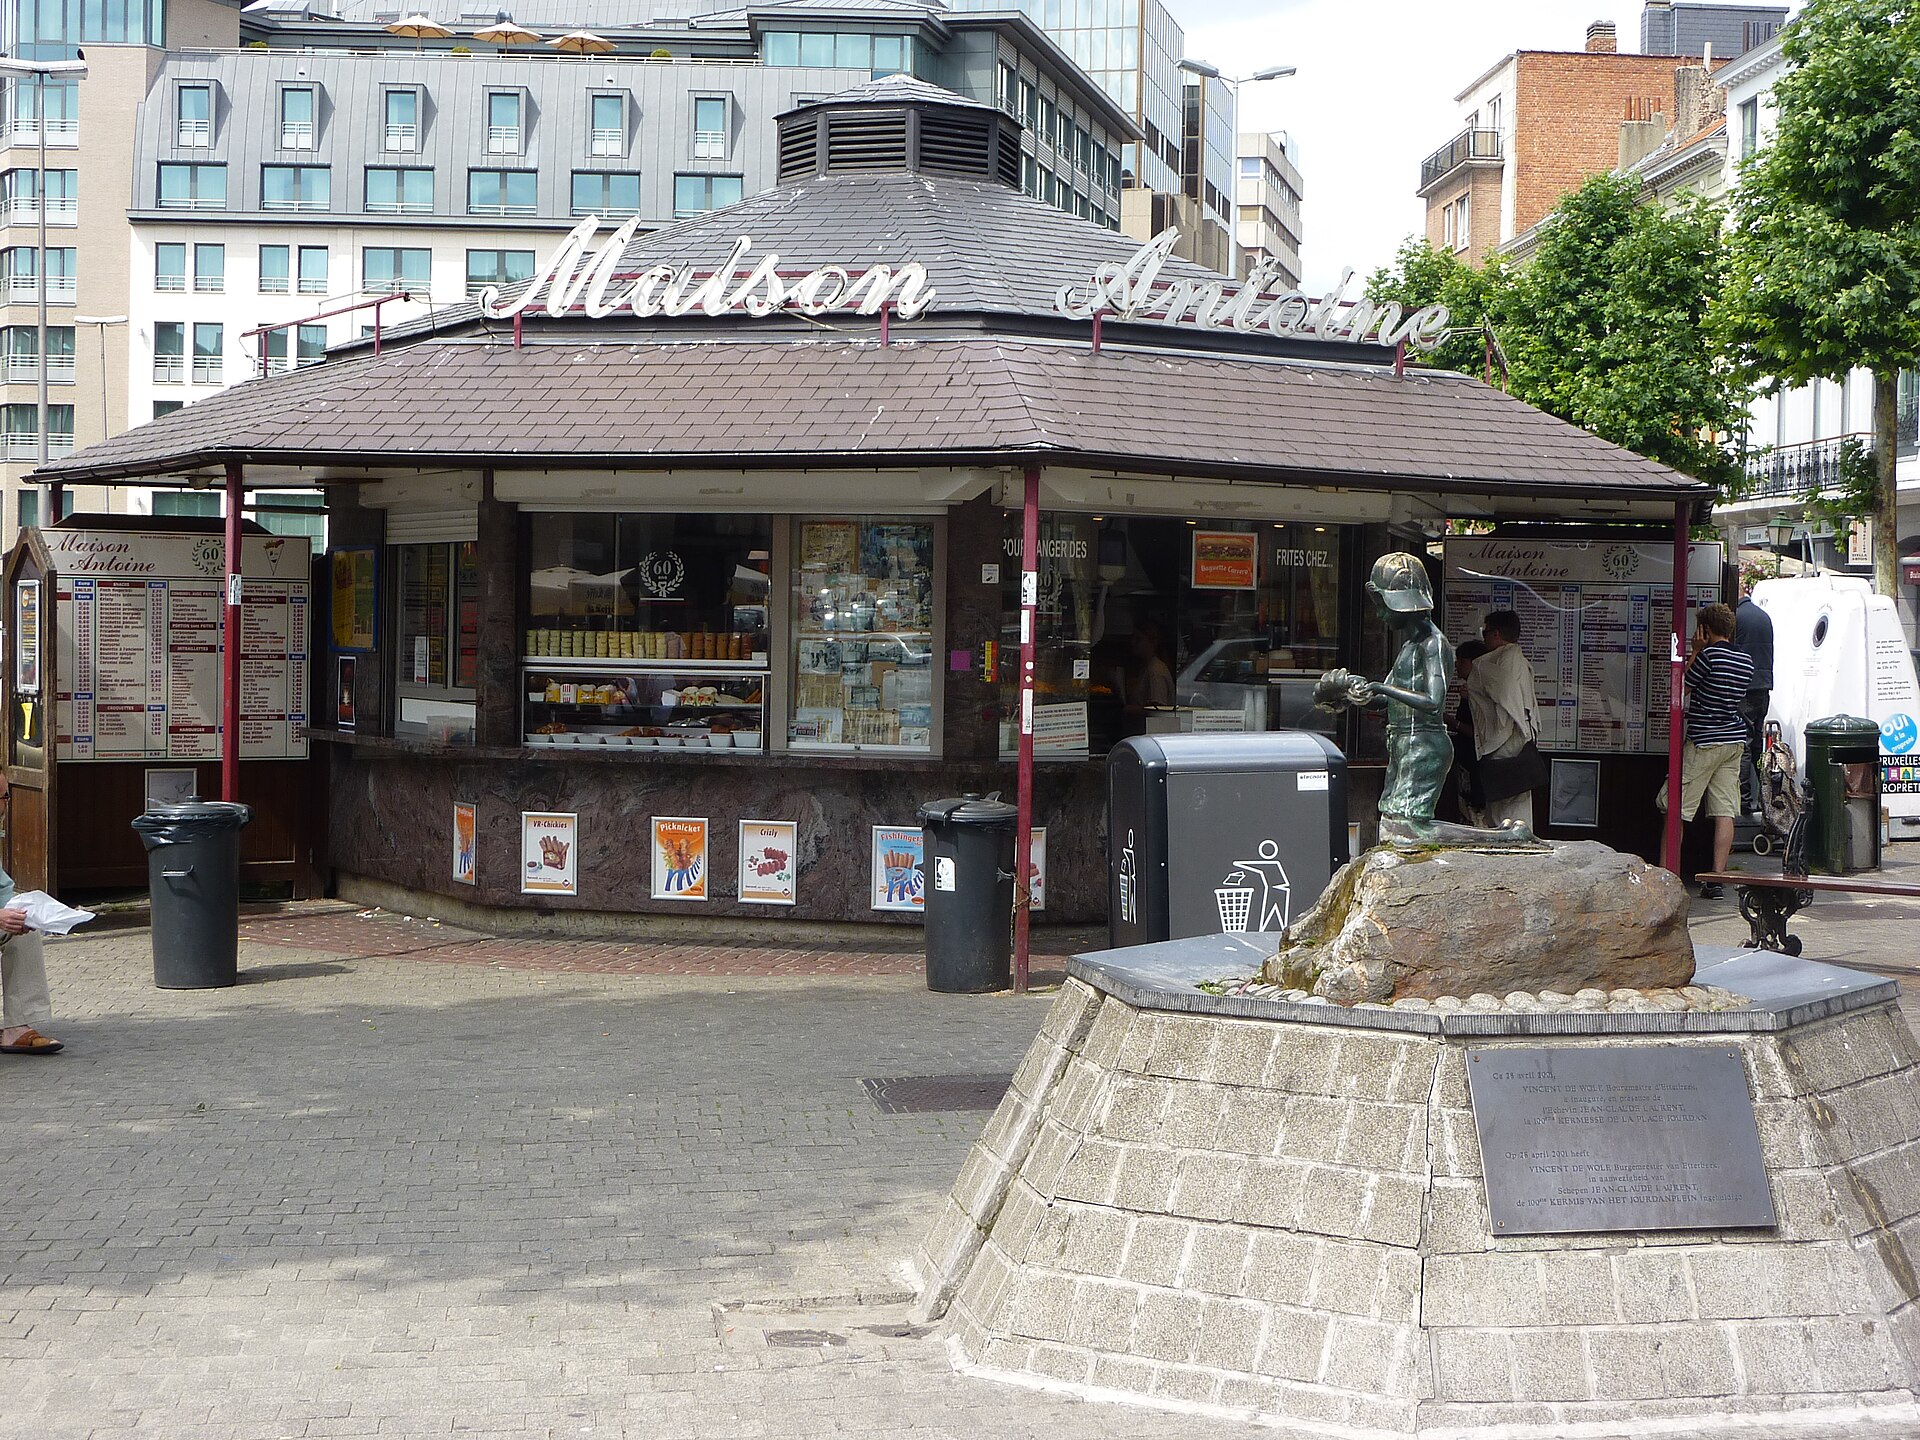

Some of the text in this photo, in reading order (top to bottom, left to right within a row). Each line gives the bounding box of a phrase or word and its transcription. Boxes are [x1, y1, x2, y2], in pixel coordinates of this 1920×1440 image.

[479, 214, 1452, 352] Maison Antoine
[48, 533, 130, 553] Maison
[1070, 540, 1087, 558] DES
[202, 548, 219, 561] 60
[1276, 548, 1304, 567] FRITES
[1469, 542, 1546, 560] Maison
[70, 552, 156, 573] Antoine
[653, 560, 672, 575] 60
[1612, 555, 1629, 567] 60
[1489, 560, 1569, 578] Antoine
[1882, 714, 1910, 736] OUI
[660, 822, 701, 832] Picknicker
[1522, 1085, 1561, 1093] VINCENT
[1558, 1116, 1604, 1124] KERMESSE
[1636, 1115, 1664, 1123] PLACE
[1666, 1114, 1708, 1122] JOURDAN
[1505, 1152, 1517, 1160] Op
[1531, 1150, 1549, 1159] april
[1552, 1150, 1568, 1158] 2001
[1570, 1150, 1590, 1158] heeft
[1529, 1165, 1569, 1173] VINCENT
[1614, 1163, 1664, 1172] Burgemeester
[1558, 1183, 1699, 1195] Schepen JEAN-CLAUDE LAURENT,
[1516, 1199, 1525, 1207] de
[1550, 1198, 1584, 1206] KERMIS
[1587, 1197, 1606, 1205] VAN
[1608, 1196, 1626, 1204] HET
[1630, 1194, 1697, 1204] JOURDANPLEIN
